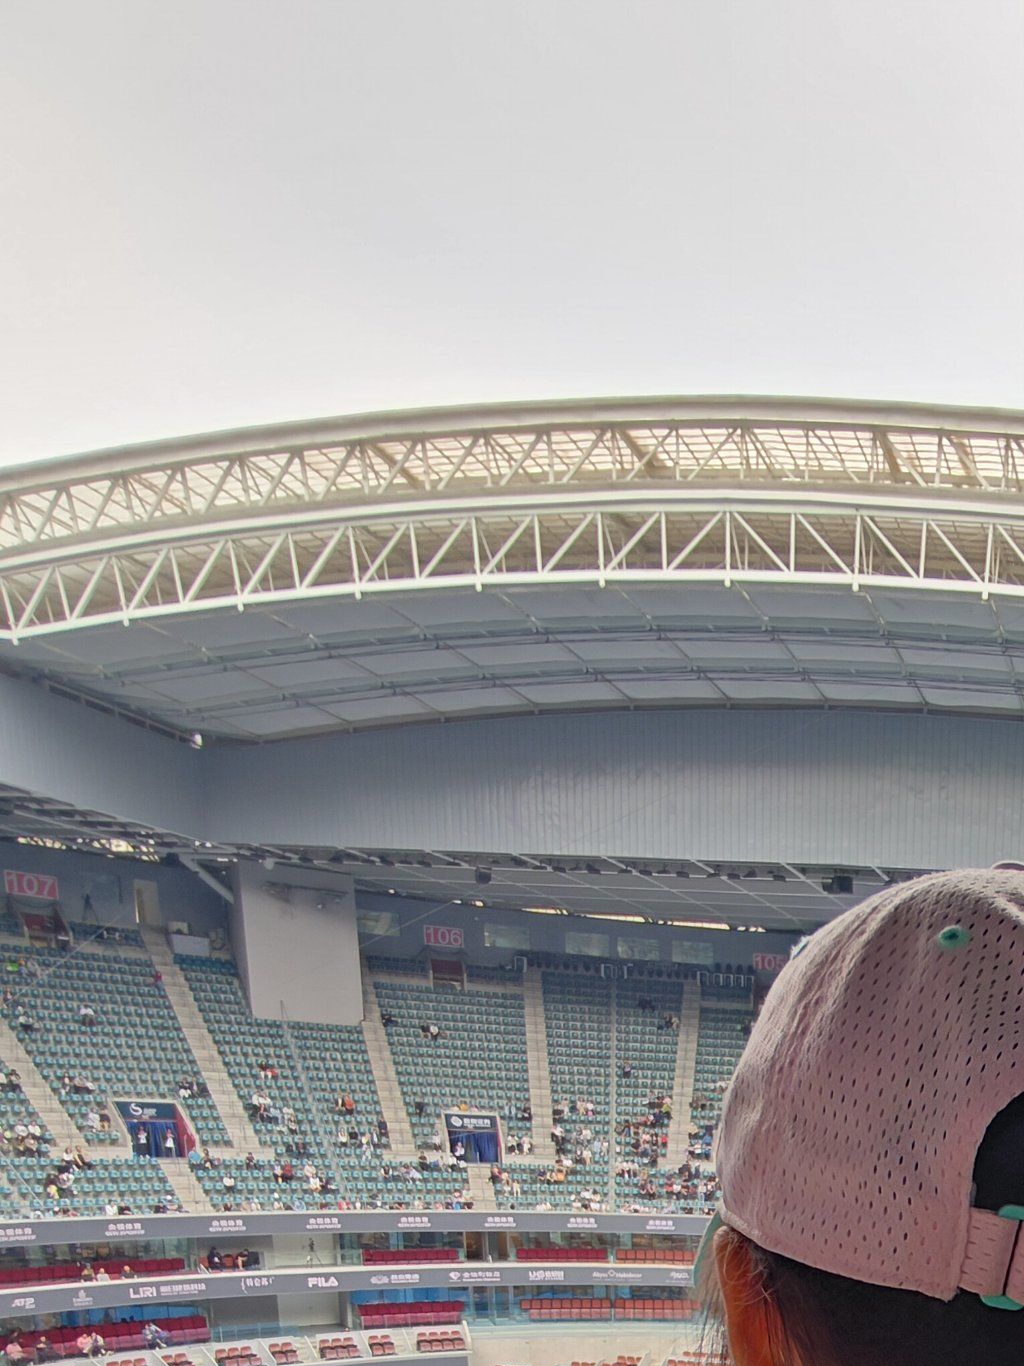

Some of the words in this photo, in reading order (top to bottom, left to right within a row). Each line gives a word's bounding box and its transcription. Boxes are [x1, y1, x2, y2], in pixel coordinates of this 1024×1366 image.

[8, 873, 53, 896] 107
[427, 927, 462, 946] 106
[307, 1276, 339, 1288] FILA
[129, 1286, 156, 1299] LIRI
